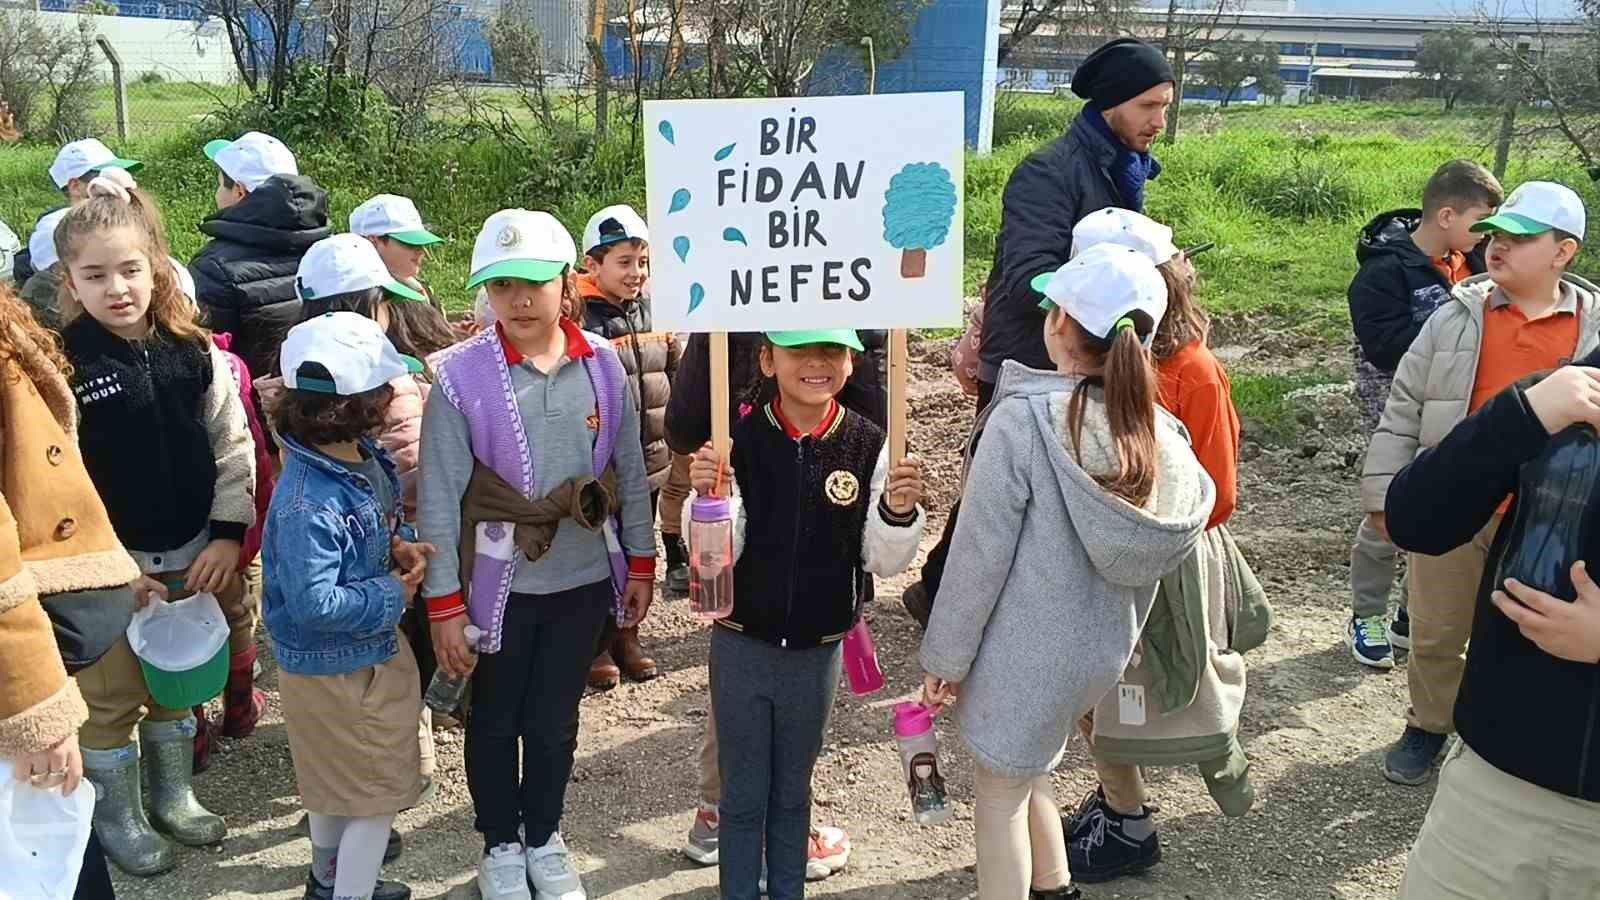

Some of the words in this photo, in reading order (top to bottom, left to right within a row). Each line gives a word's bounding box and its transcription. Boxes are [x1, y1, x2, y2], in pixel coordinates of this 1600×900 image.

[760, 107, 818, 156] BİR
[718, 160, 865, 206] FİDAN
[768, 205, 828, 248] BİR
[730, 257, 872, 306] NEFES
